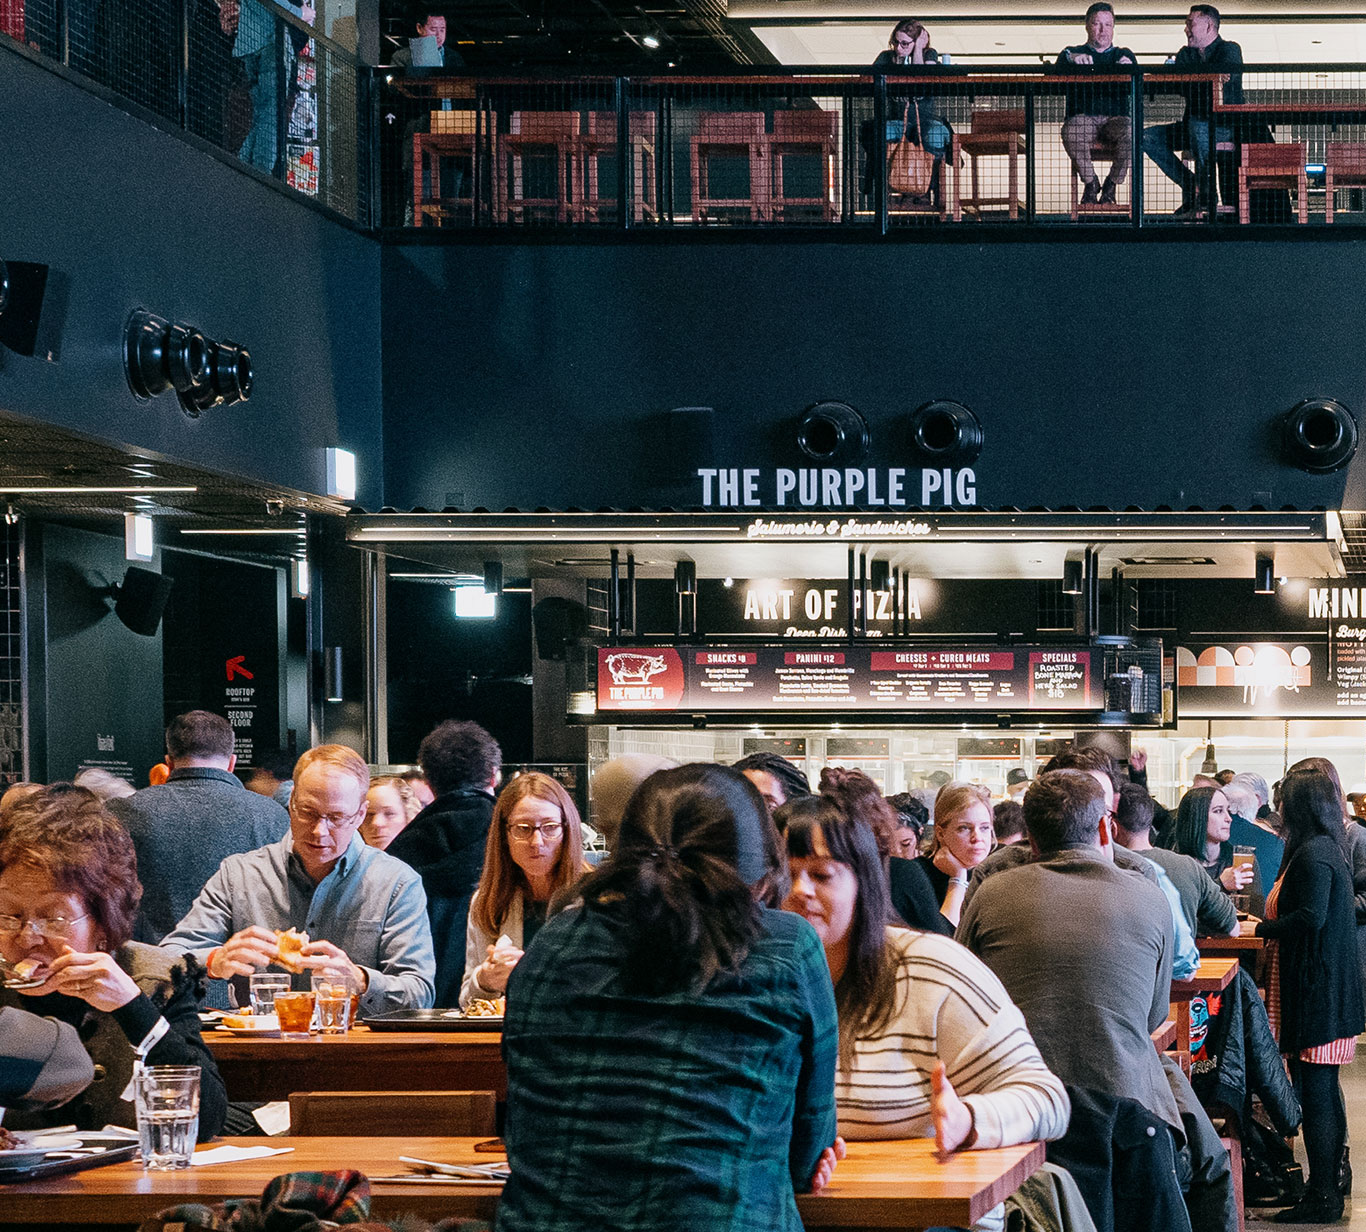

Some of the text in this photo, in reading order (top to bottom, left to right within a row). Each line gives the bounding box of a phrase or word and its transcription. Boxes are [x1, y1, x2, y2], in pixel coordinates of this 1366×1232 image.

[697, 467, 976, 505] THE PURPLE PIG
[747, 519, 931, 538] Salumerie & Sandwiches
[744, 589, 794, 620] ART
[805, 589, 838, 620] OF
[707, 653, 737, 663] SNACKS
[796, 653, 822, 664] PANINI
[896, 653, 928, 663] CHEESES
[940, 653, 964, 663] CURED
[965, 653, 990, 663] MEATS
[1042, 653, 1077, 663] SPECIALS
[1040, 664, 1075, 672] ROASTED
[1336, 666, 1362, 674] Original
[1055, 671, 1083, 679] MARROW
[225, 688, 255, 696] ROOFTOP
[227, 711, 254, 719] SECOND
[230, 719, 251, 727] FLOOR
